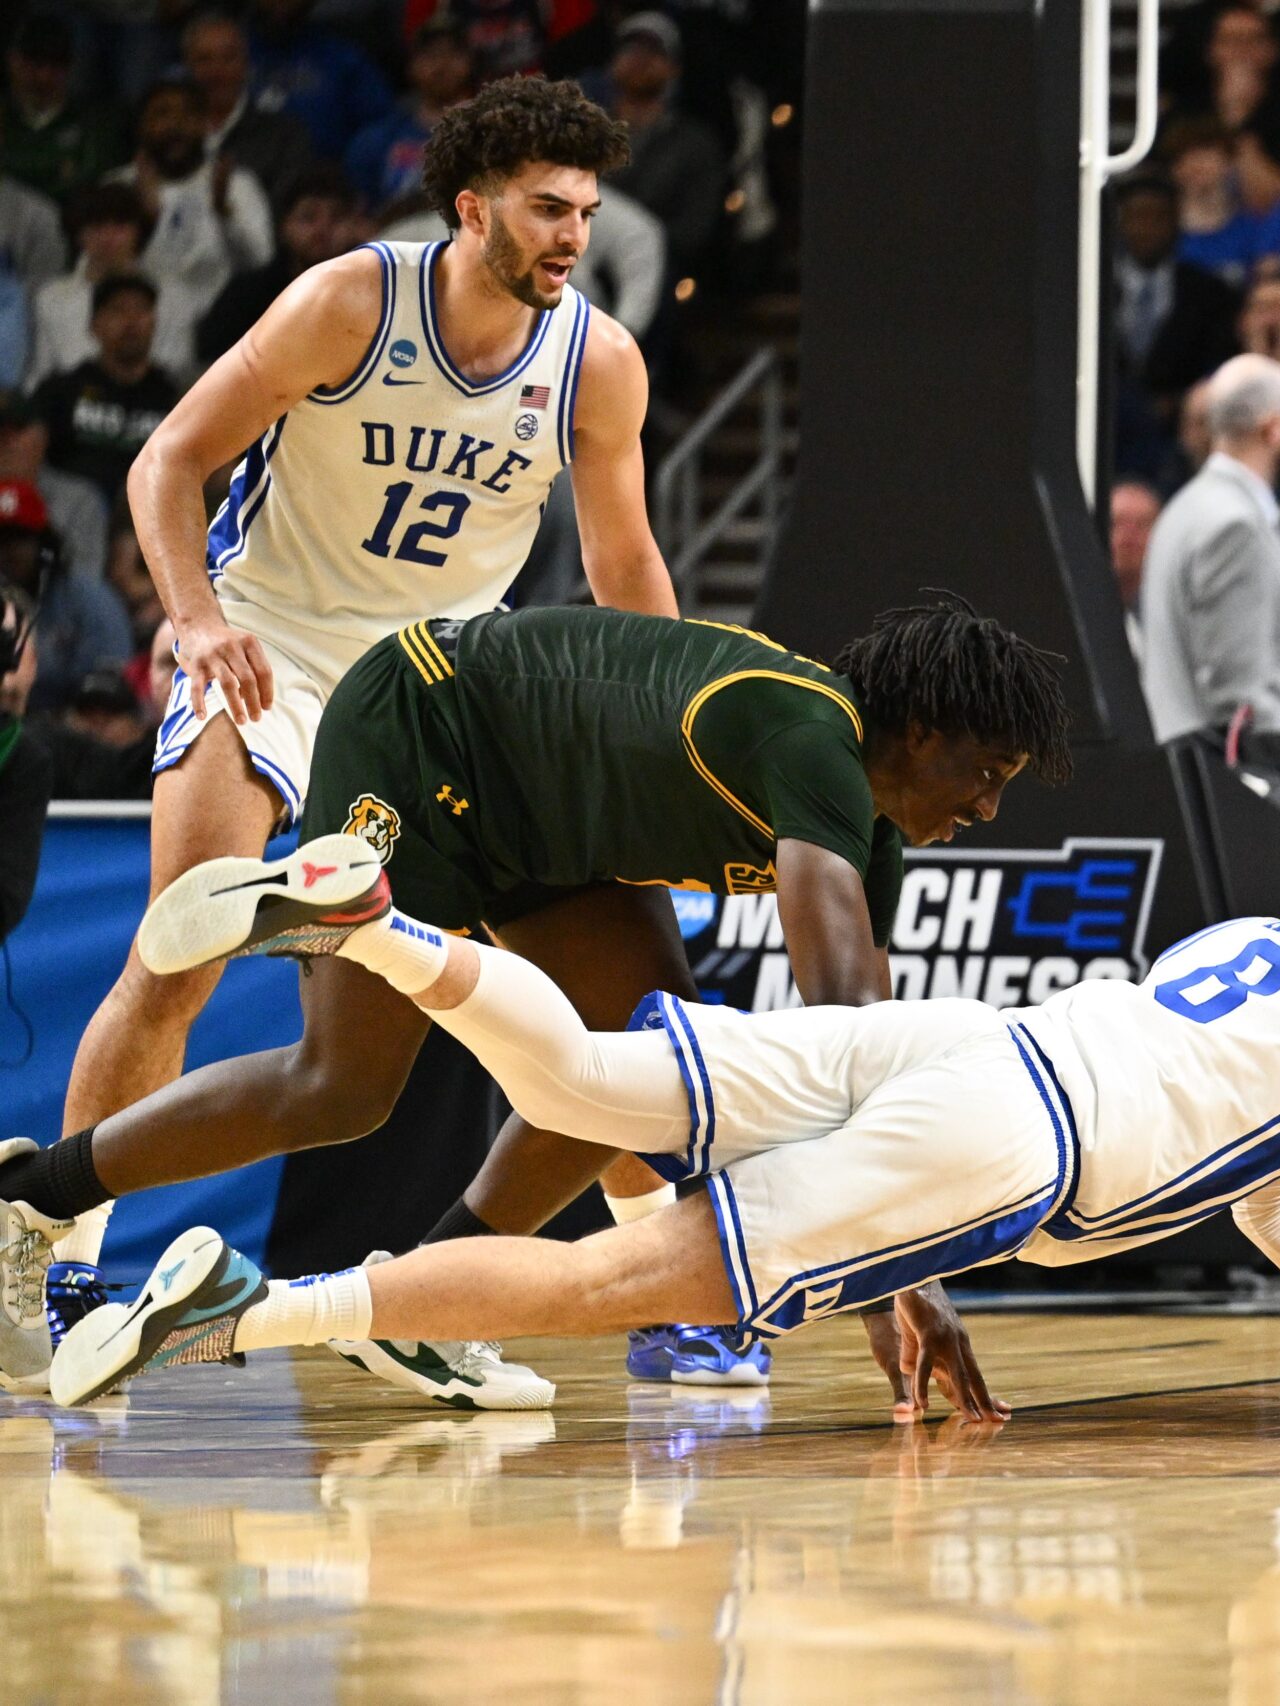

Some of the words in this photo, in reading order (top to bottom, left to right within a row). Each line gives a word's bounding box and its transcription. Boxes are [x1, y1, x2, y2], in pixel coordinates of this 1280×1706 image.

[361, 421, 532, 494] DUKE
[361, 481, 471, 567] 12
[716, 868, 1002, 952] MCH
